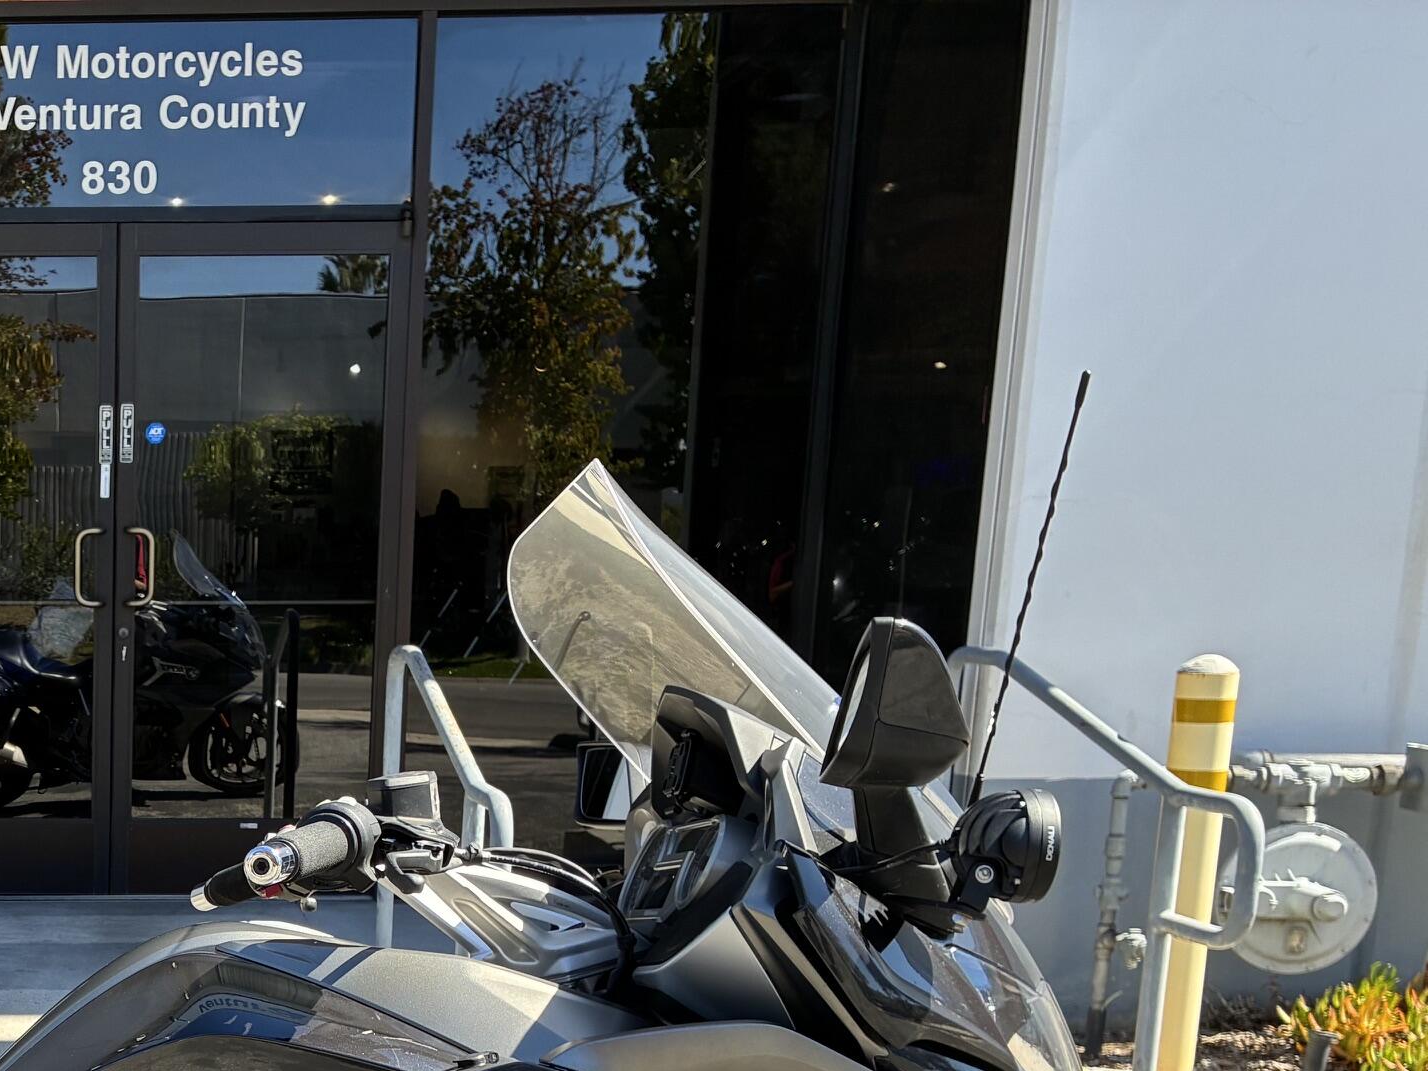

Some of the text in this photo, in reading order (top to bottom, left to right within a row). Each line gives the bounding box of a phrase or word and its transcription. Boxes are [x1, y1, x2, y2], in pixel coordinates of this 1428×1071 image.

[56, 42, 304, 87] Motorcycles
[159, 95, 306, 137] County
[81, 161, 158, 195] 830
[102, 411, 111, 449] PULL
[123, 409, 132, 448] PULL
